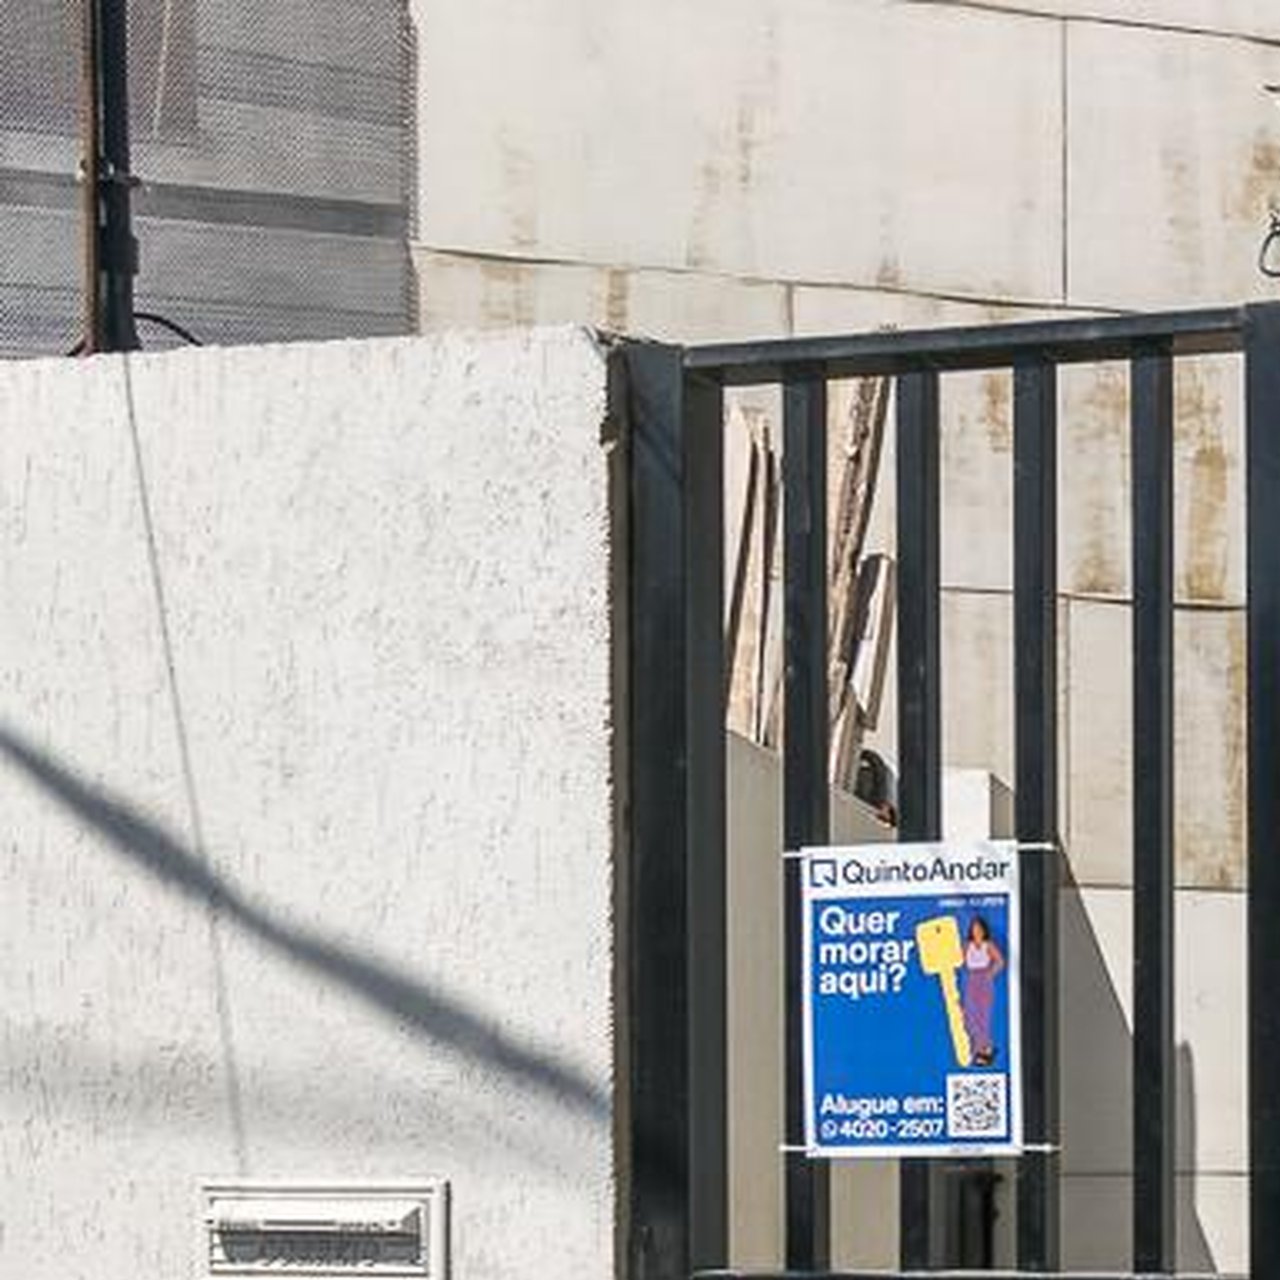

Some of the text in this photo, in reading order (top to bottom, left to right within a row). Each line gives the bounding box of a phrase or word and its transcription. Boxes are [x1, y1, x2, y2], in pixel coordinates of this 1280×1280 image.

[842, 857, 1010, 884] QuintoAndar
[819, 906, 900, 935] Quer
[819, 939, 914, 965] morar
[819, 964, 906, 999] aqui?
[820, 1092, 945, 1118] Alugue em:
